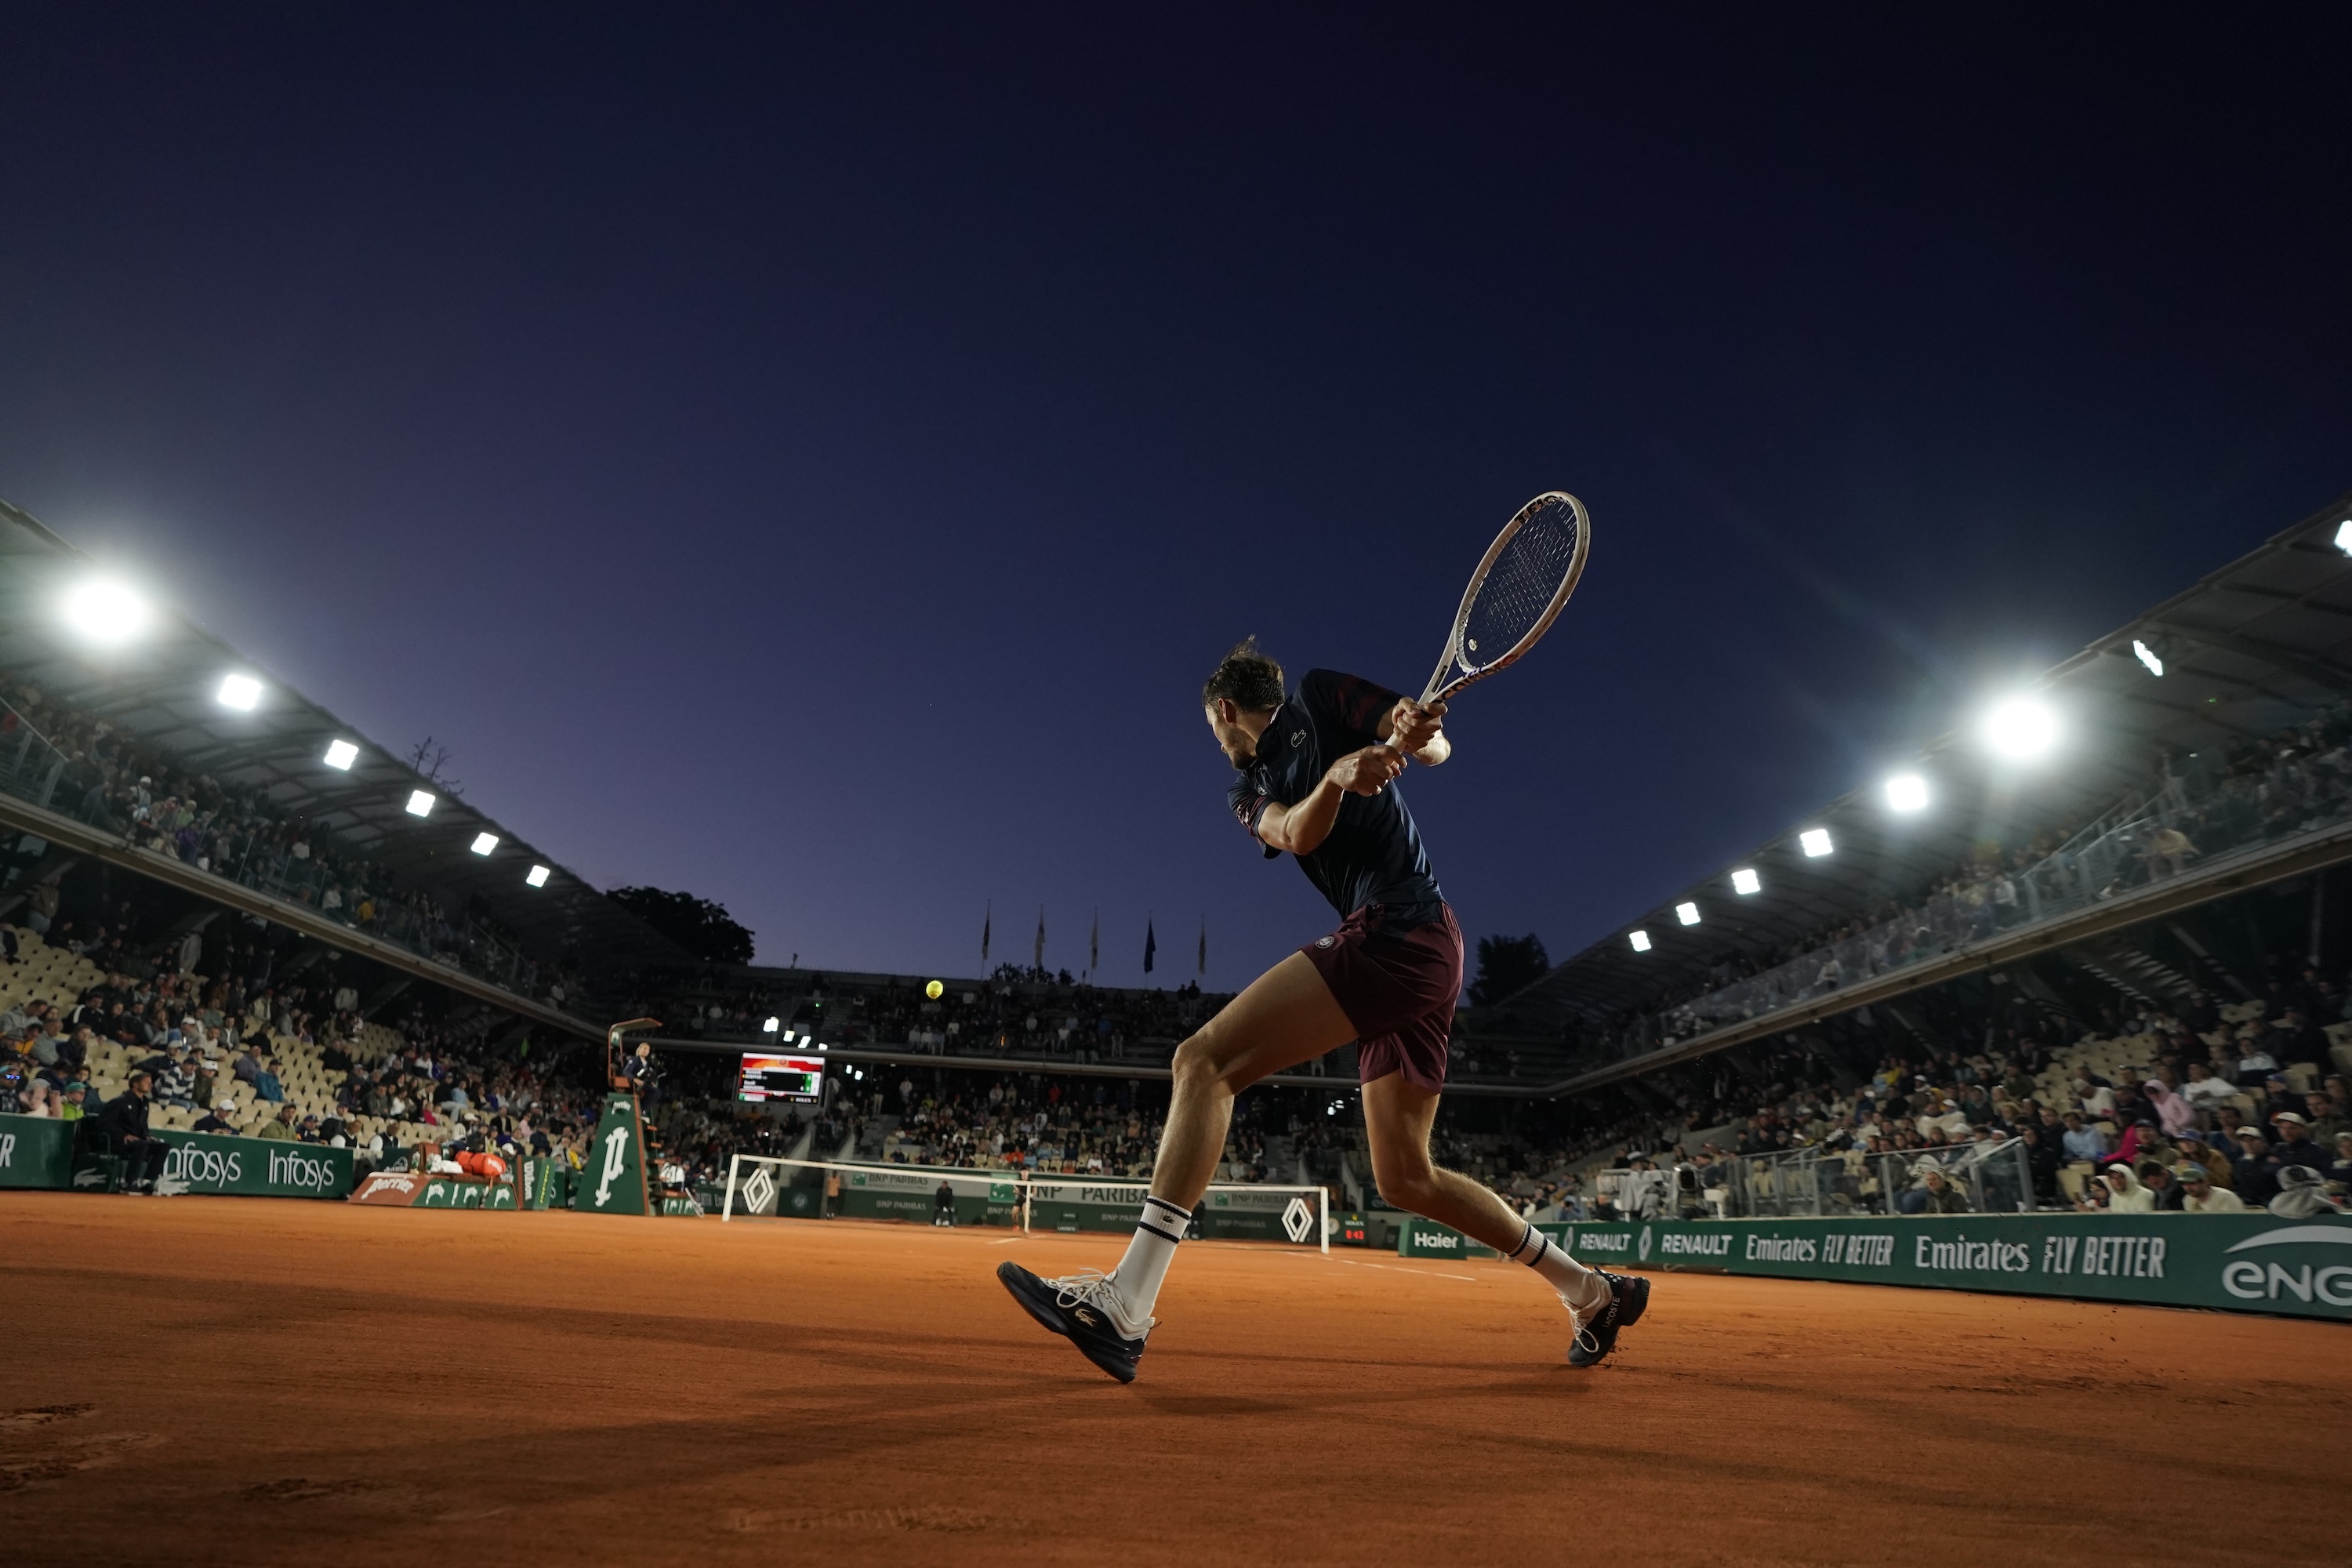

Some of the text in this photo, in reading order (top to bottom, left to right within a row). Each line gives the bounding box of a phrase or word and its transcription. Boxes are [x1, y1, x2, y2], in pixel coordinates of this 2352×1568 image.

[0, 1134, 16, 1168] R
[163, 1142, 241, 1189] nfosys
[268, 1149, 335, 1192] Infosys
[869, 1174, 928, 1185] BNP PARIBAS
[1036, 1186, 1149, 1203] NP PARIBA
[876, 1200, 927, 1210] BNP PARIBAS
[987, 1207, 1004, 1215] BNP
[1414, 1232, 1458, 1249] Haier
[1579, 1233, 1632, 1251] RENAULT
[1661, 1234, 1733, 1254] RENAULT
[1745, 1233, 1894, 1265] Emirates FLY BETTER
[1915, 1235, 2166, 1278] Emirates FLY BETTER
[1602, 1295, 1621, 1328] LACOSTE
